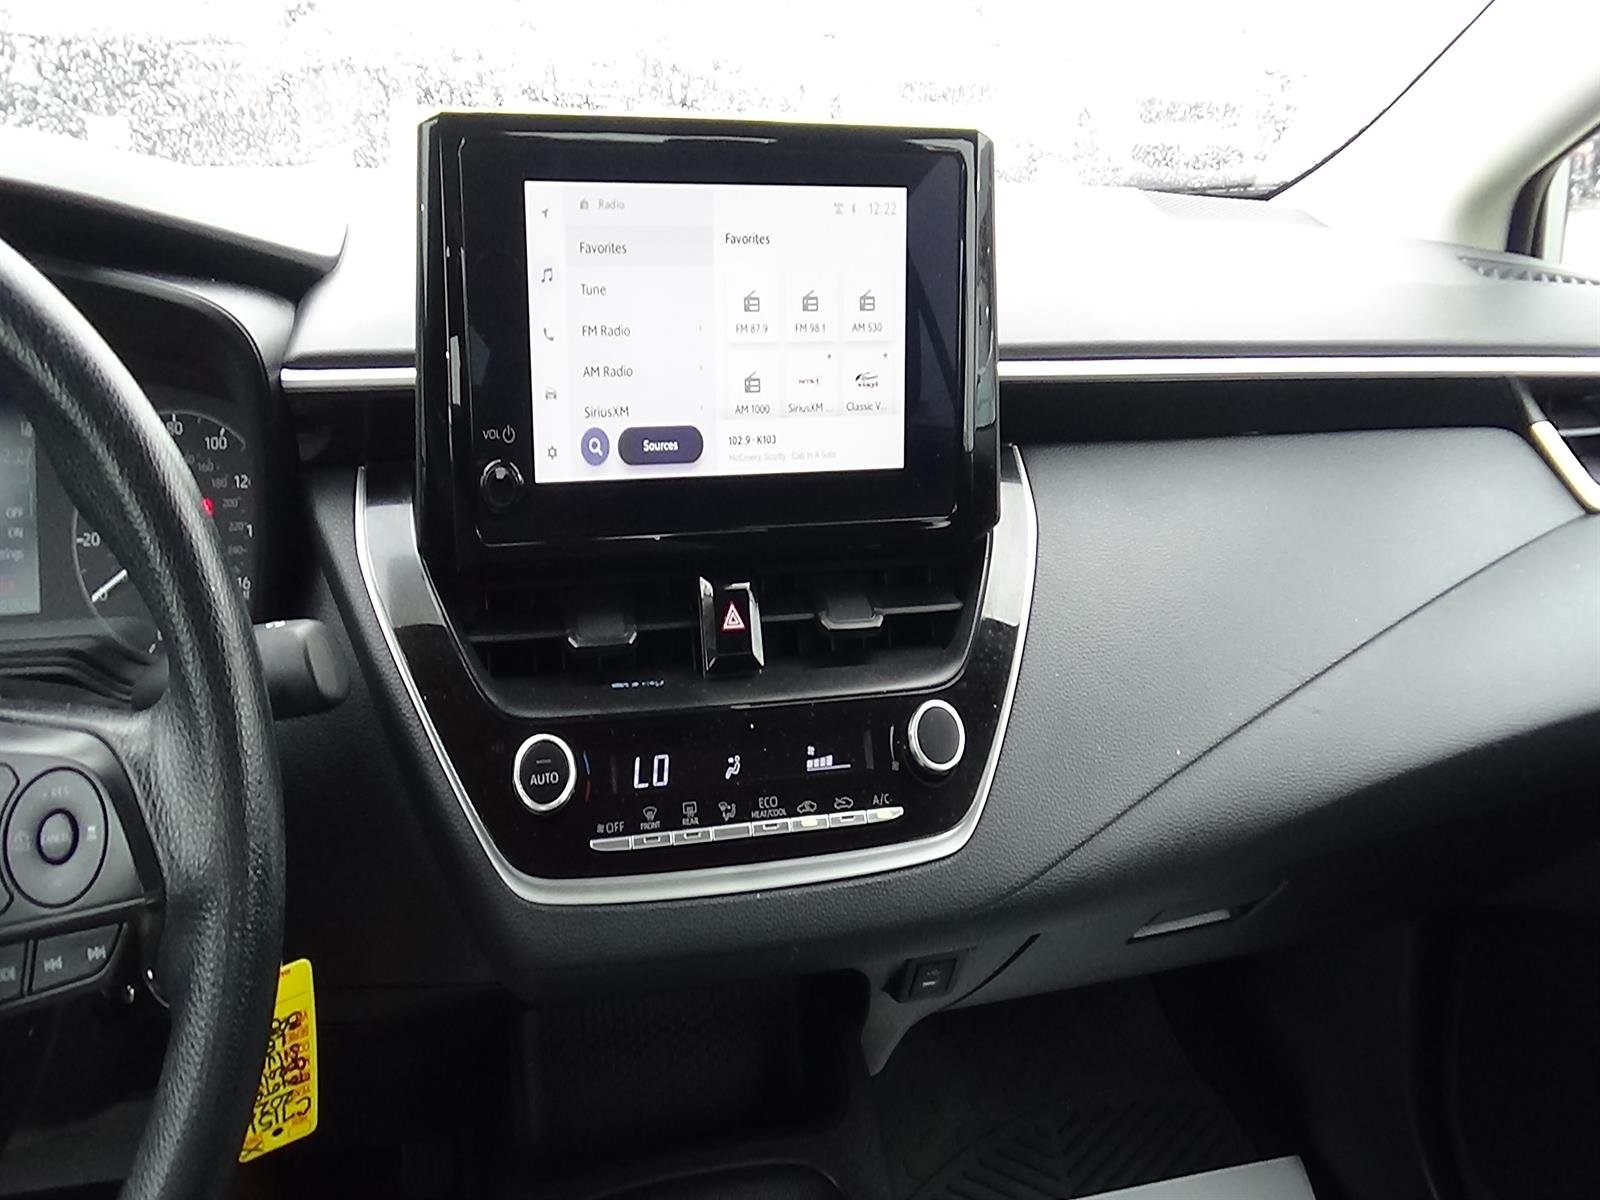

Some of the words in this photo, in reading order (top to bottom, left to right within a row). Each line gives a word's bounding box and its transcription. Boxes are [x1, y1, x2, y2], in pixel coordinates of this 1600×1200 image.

[597, 199, 625, 210] Radio
[725, 232, 770, 245] Favorites
[579, 241, 627, 255] Favorites
[581, 283, 606, 296] Tune
[582, 325, 598, 337] FM
[600, 324, 631, 337] Radio
[735, 323, 748, 333] FM
[795, 323, 808, 333] FM
[852, 323, 866, 333] AM
[583, 366, 600, 378] AM
[603, 365, 634, 378] Radio
[584, 406, 630, 419] SiriusXM
[735, 405, 749, 415] AM
[751, 403, 770, 414] 1000
[846, 401, 873, 412] Classic
[482, 428, 501, 440] VOL
[756, 434, 777, 445] K103
[204, 436, 228, 450] 100
[642, 438, 679, 453] Sources
[234, 474, 252, 489] 12
[529, 770, 560, 786] AUTO
[633, 754, 670, 789] LO
[758, 796, 779, 809] ECO
[872, 794, 890, 806] A/C
[751, 808, 788, 819] HEAT/COOL
[605, 821, 625, 834] OFF
[640, 821, 661, 831] FRONT
[682, 817, 700, 826] REAR
